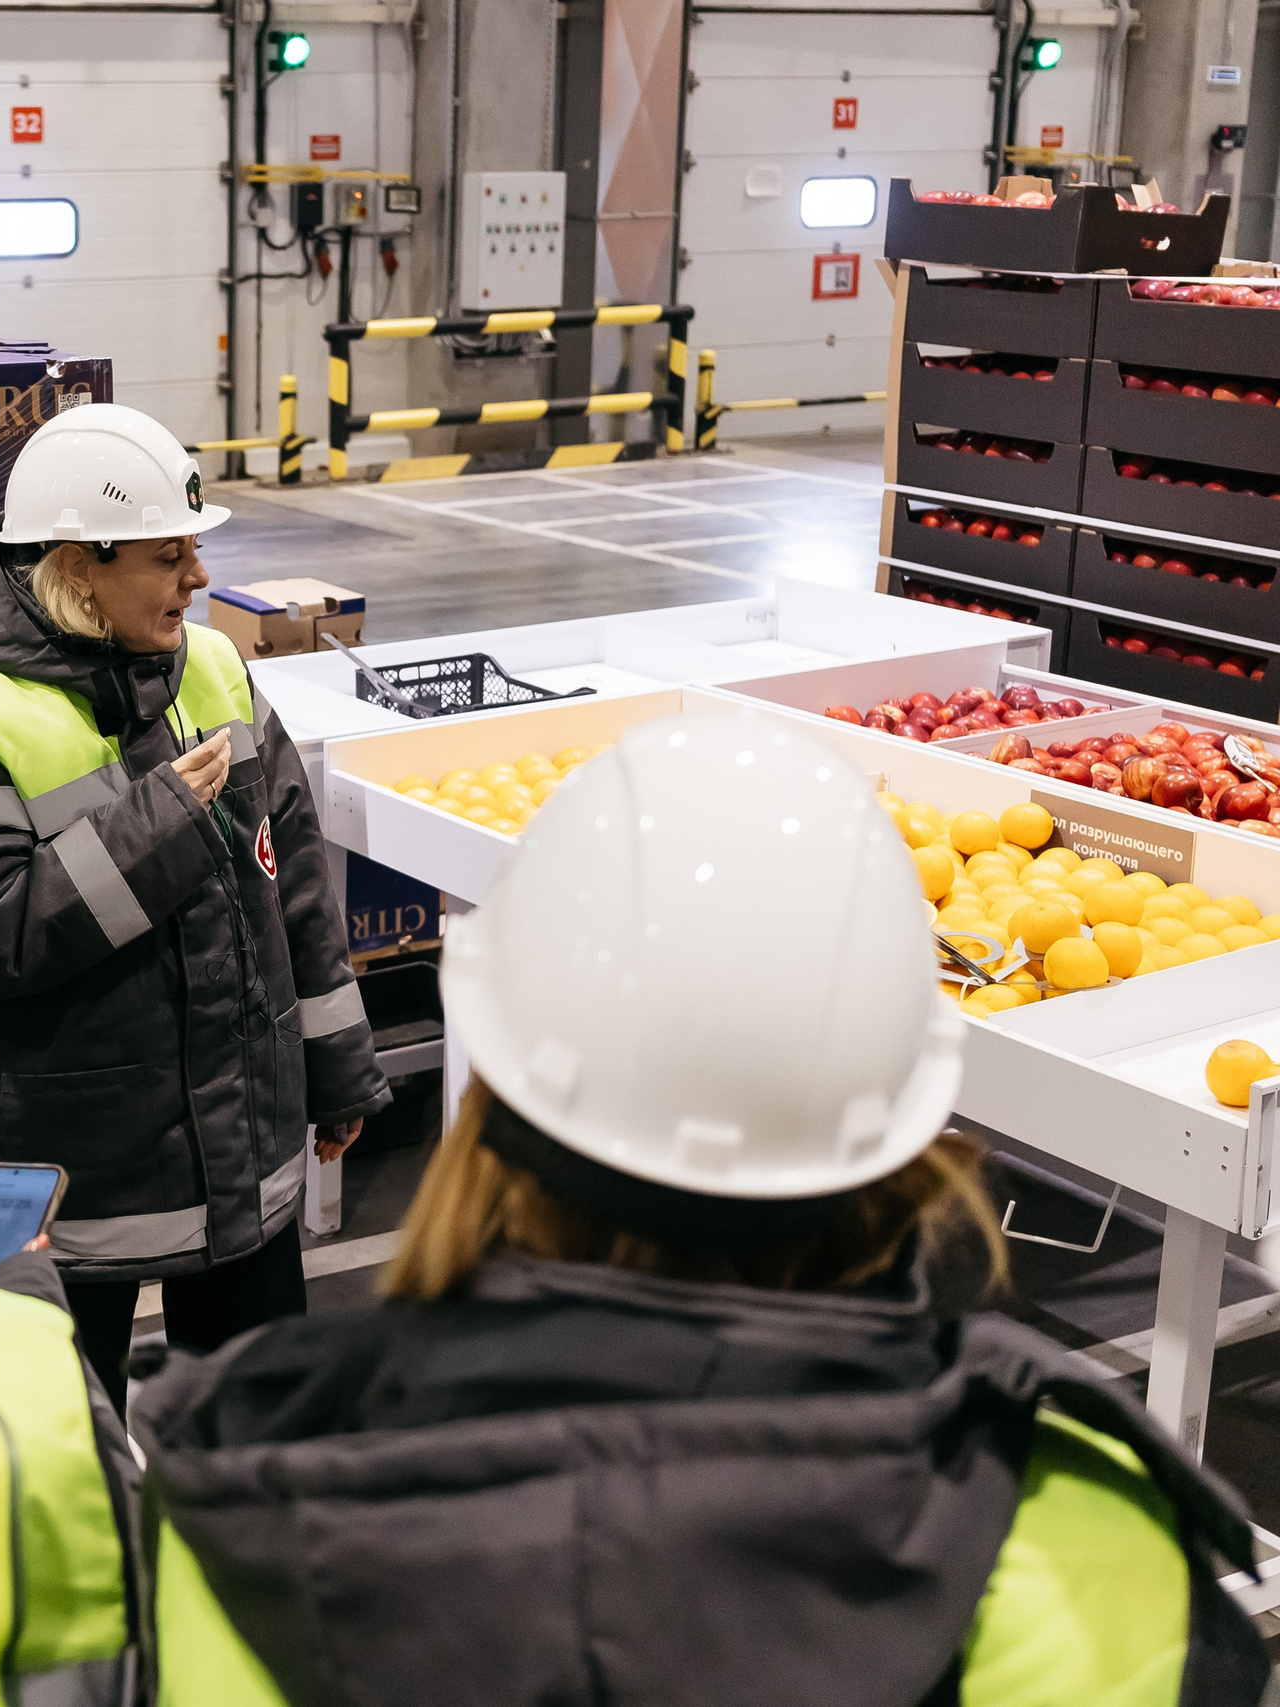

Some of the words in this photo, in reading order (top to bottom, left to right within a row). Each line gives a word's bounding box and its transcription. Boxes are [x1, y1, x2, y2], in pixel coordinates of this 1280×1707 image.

[14, 112, 40, 133] 32
[1070, 822, 1184, 863] разрушающего
[1073, 841, 1139, 870] контроля
[352, 904, 426, 941] CITR
